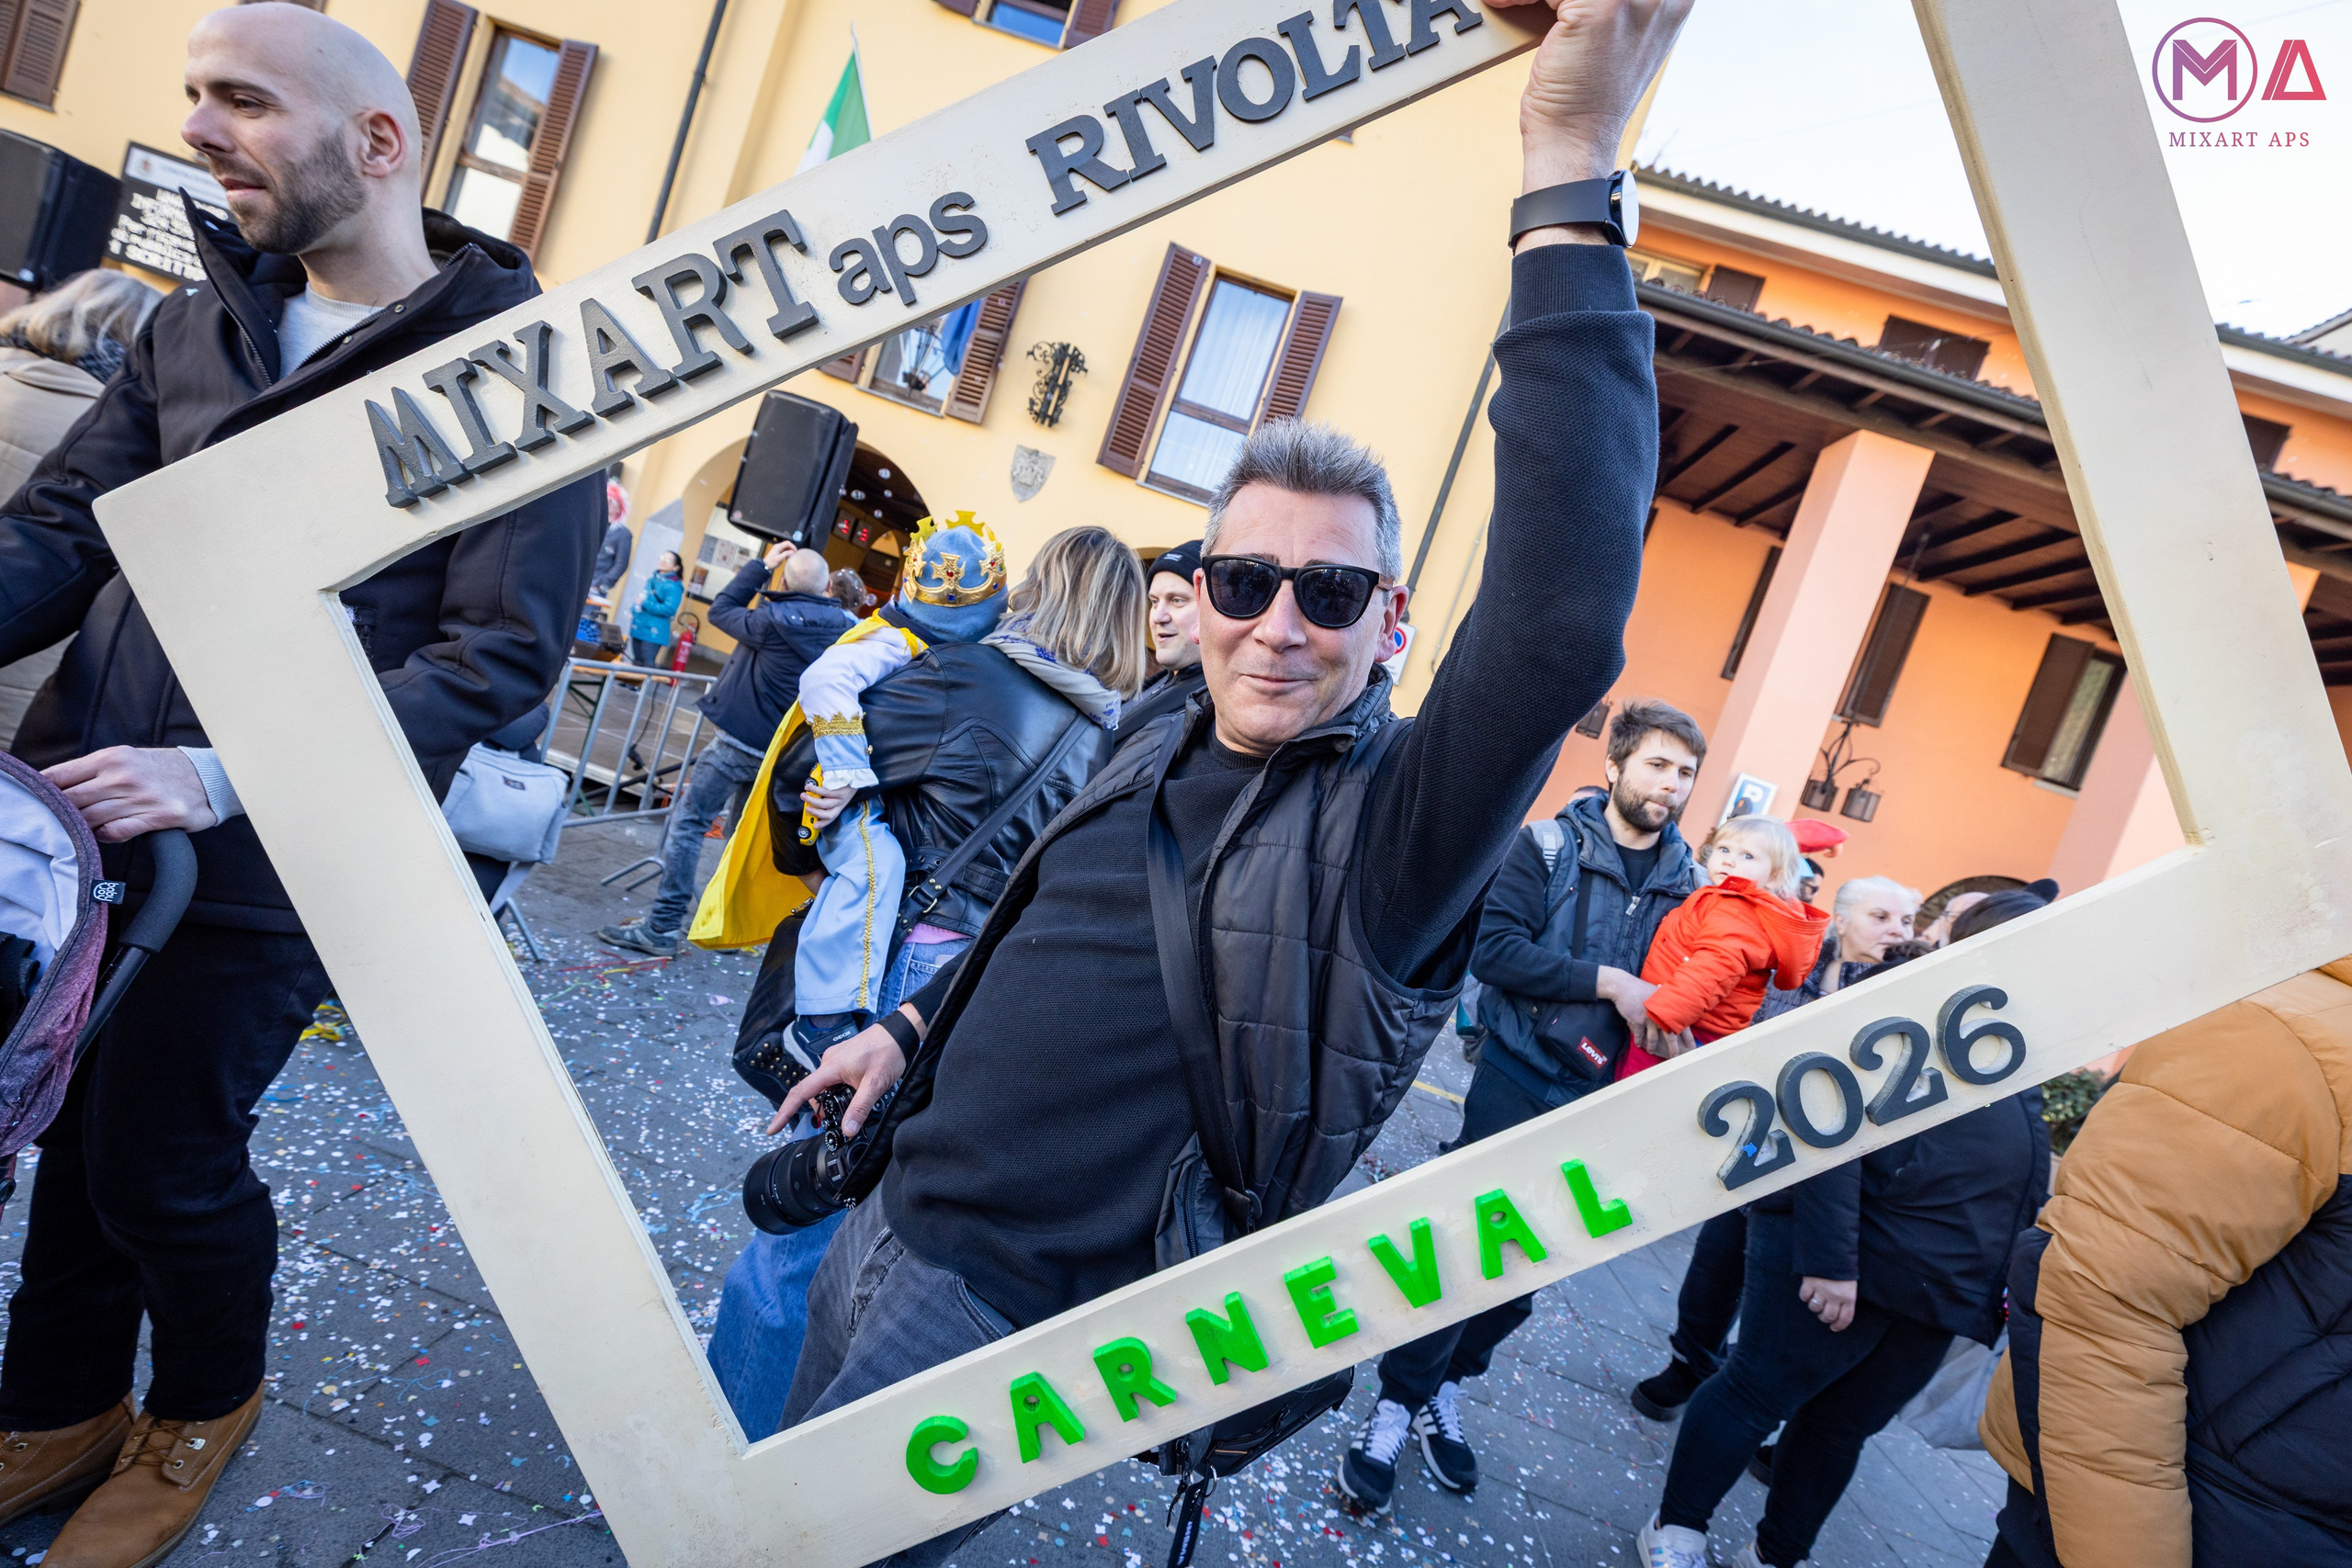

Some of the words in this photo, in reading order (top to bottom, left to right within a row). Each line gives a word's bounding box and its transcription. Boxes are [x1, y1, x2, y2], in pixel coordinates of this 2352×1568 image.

[365, 209, 819, 508] MIXART
[829, 191, 988, 305] aps
[1025, 0, 1483, 215] RIVOLTA
[906, 1159, 1633, 1495] CARNEVAL
[1697, 985, 2027, 1191] 2026
